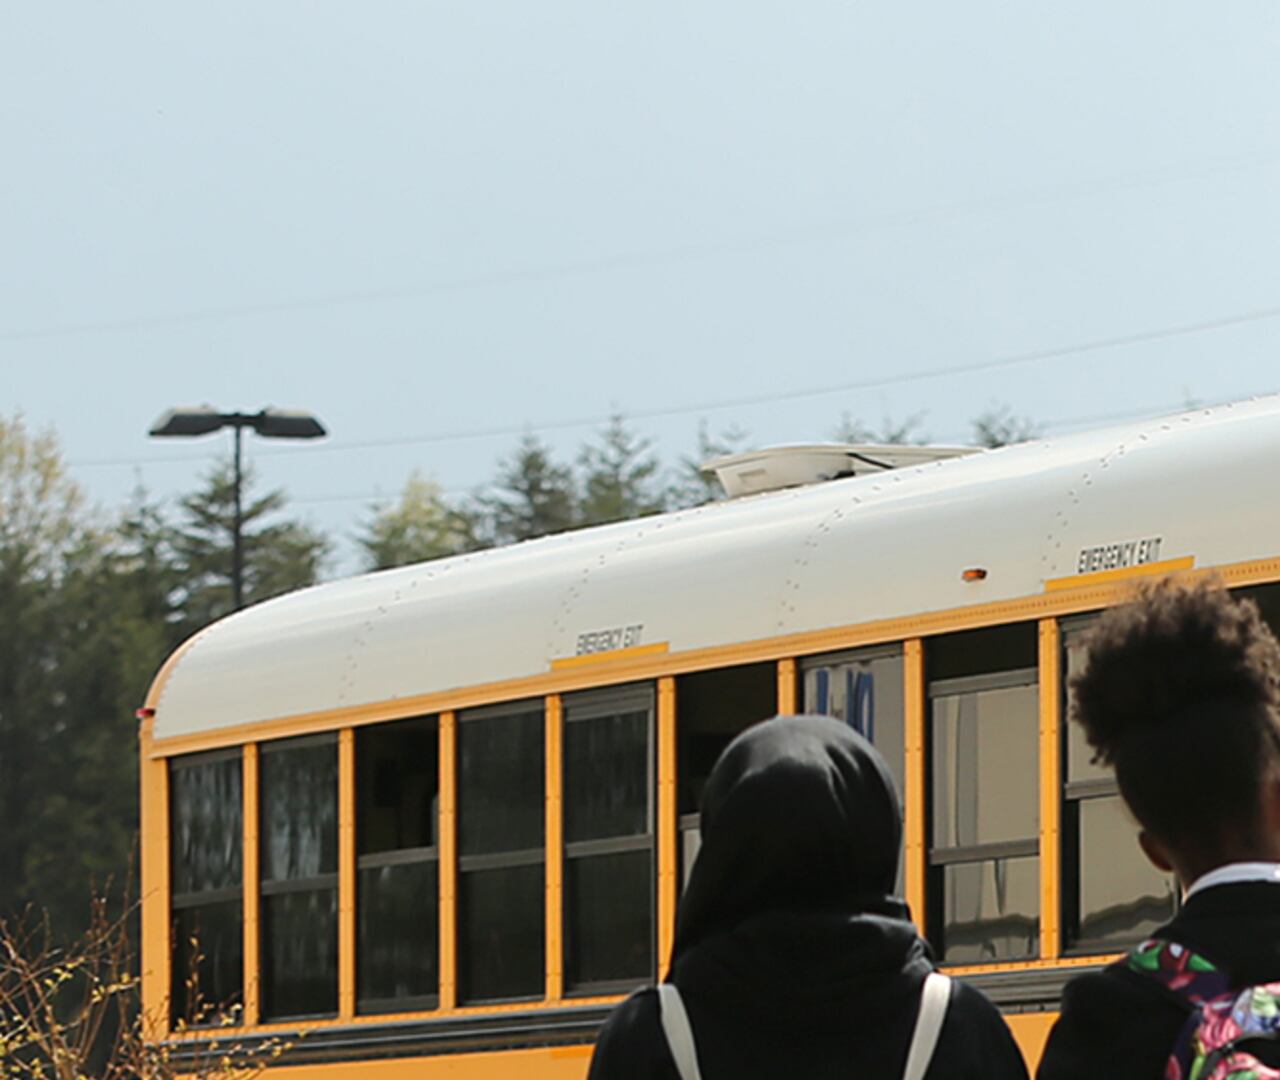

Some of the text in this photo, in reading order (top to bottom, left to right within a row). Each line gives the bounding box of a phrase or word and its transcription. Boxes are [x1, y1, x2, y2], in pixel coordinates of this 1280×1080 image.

[1078, 538, 1162, 573] EMERGENCY EXIT
[576, 624, 643, 655] EMERGENCY EXIT
